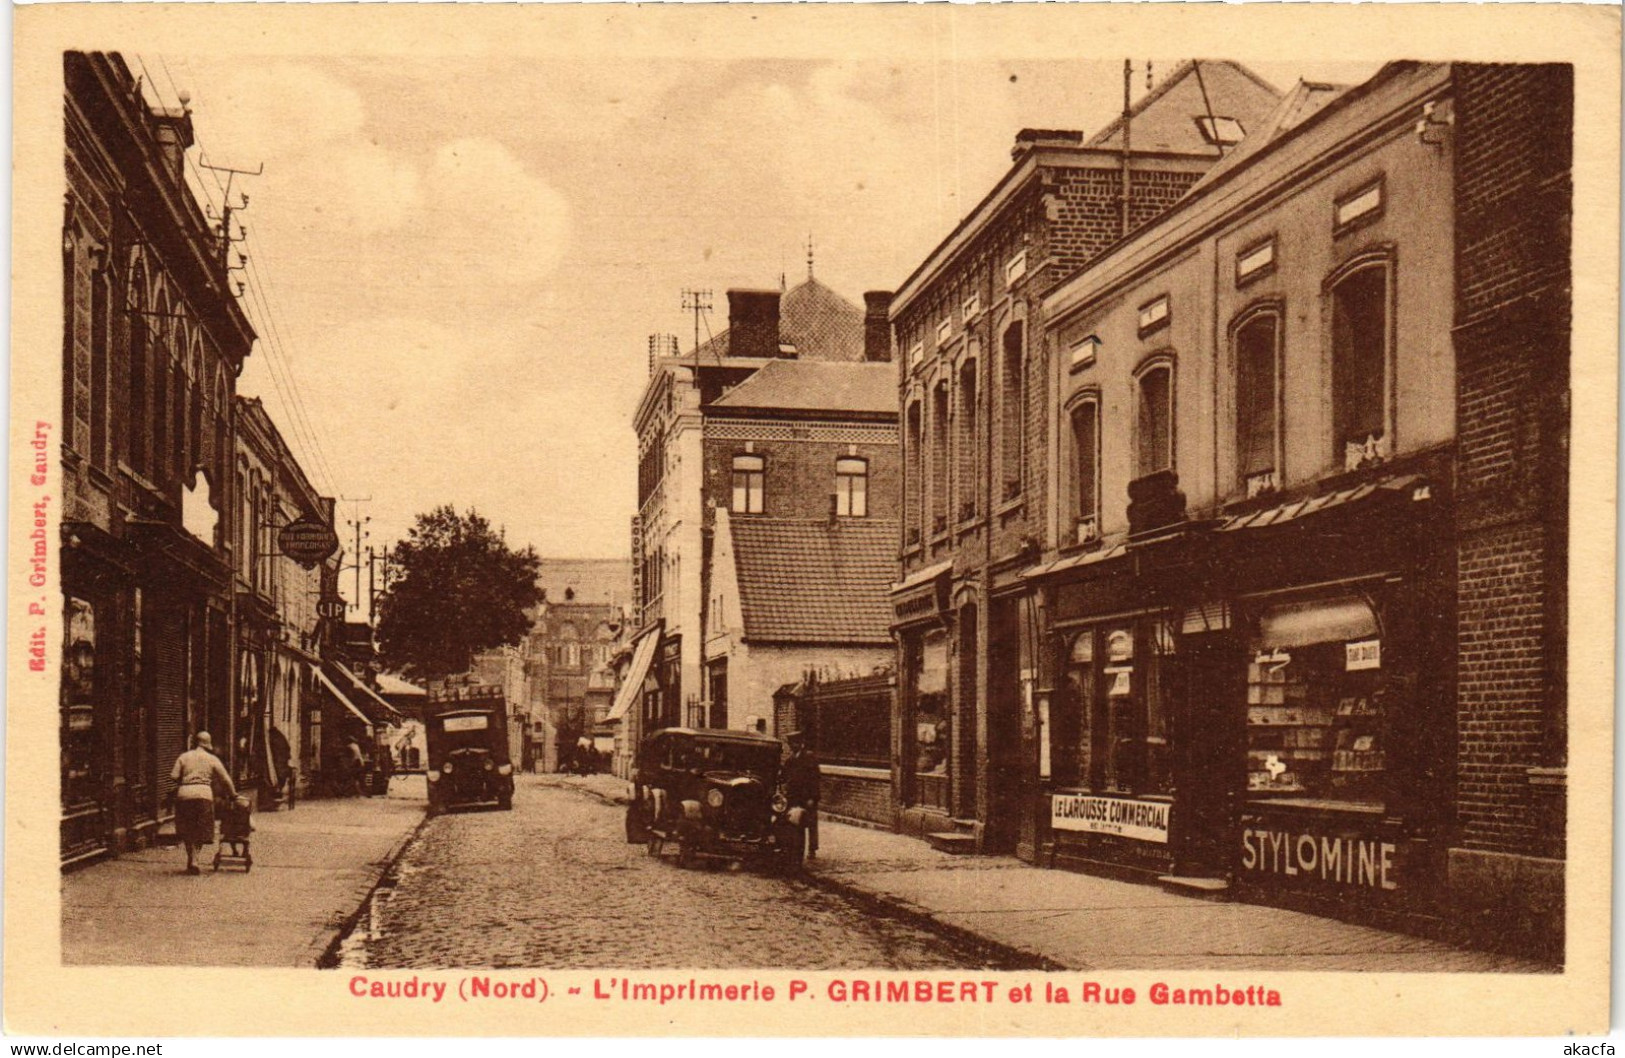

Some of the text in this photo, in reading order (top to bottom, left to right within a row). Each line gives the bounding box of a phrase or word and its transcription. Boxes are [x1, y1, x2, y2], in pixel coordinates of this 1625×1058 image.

[632, 516, 641, 626] COOPERATIVE
[319, 602, 344, 618] LIP
[1055, 797, 1063, 817] LE
[1063, 797, 1108, 822] LAROUSSE
[1109, 801, 1167, 831] COMMERCIAL
[1242, 828, 1397, 890] STYLOMINE
